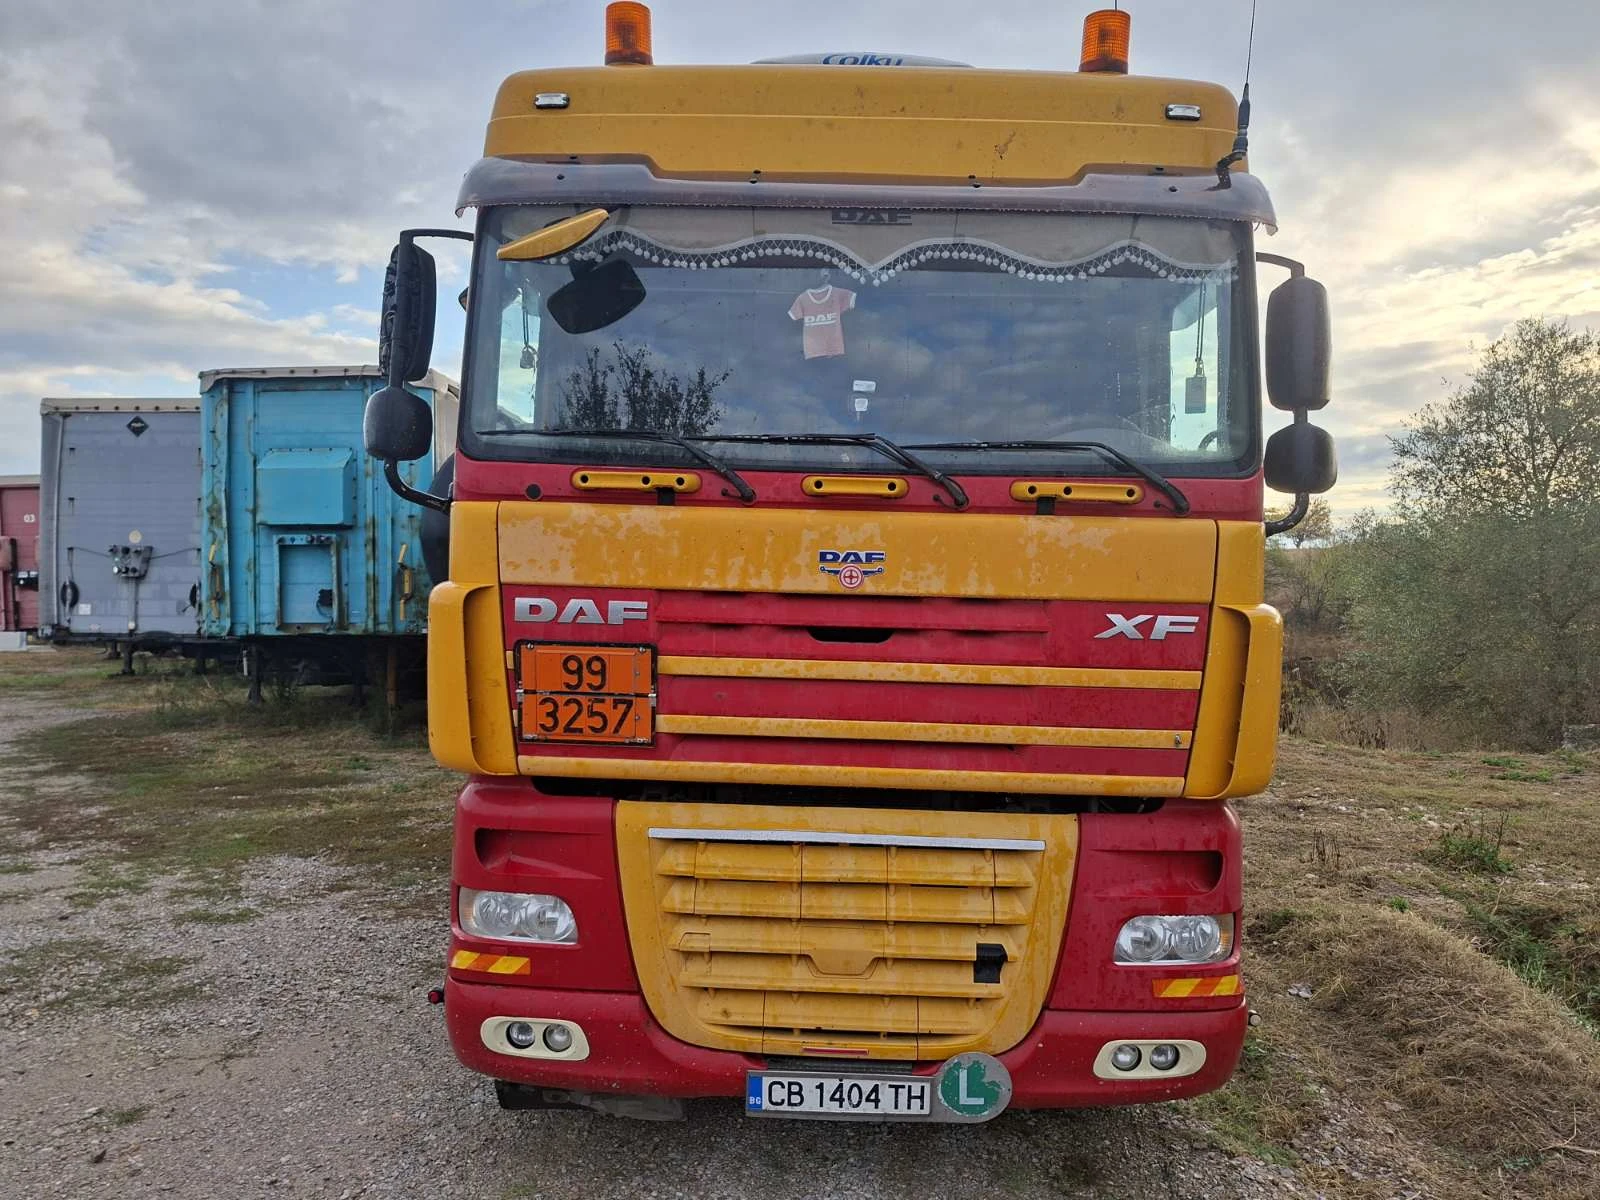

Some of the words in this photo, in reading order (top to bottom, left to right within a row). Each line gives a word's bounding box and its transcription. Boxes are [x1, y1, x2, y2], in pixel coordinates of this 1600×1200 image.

[831, 207, 912, 223] DAF
[804, 312, 837, 323] DAF
[819, 551, 885, 563] DAF
[514, 597, 648, 625] DAF
[1093, 613, 1200, 640] XF
[562, 654, 607, 691] 99
[538, 696, 634, 735] 3257
[748, 1096, 762, 1105] BG
[767, 1080, 805, 1107] CB
[815, 1081, 881, 1109] 1404
[888, 1084, 926, 1110] TH
[959, 1069, 985, 1105] L
